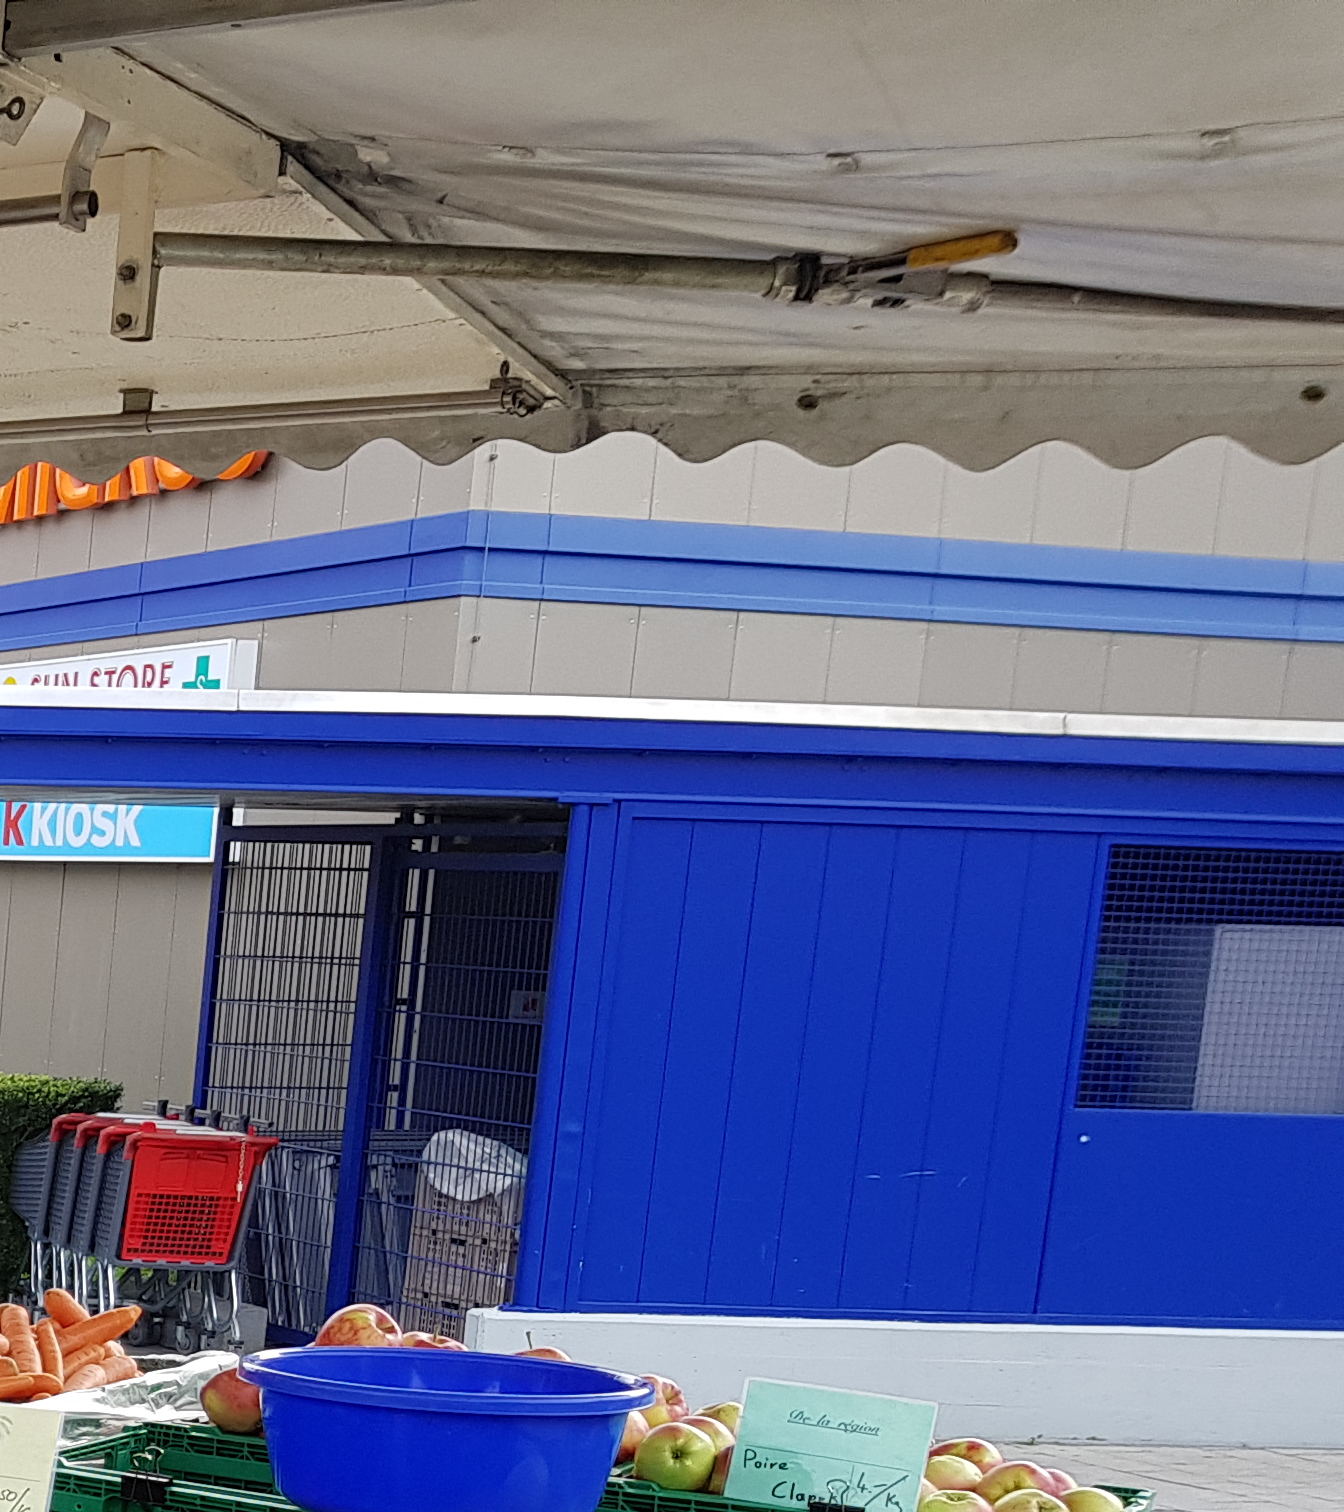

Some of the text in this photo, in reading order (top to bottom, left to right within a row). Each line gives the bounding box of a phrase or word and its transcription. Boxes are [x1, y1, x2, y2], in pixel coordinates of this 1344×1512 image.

[788, 1408, 880, 1438] De la région
[743, 1448, 789, 1470] Poire
